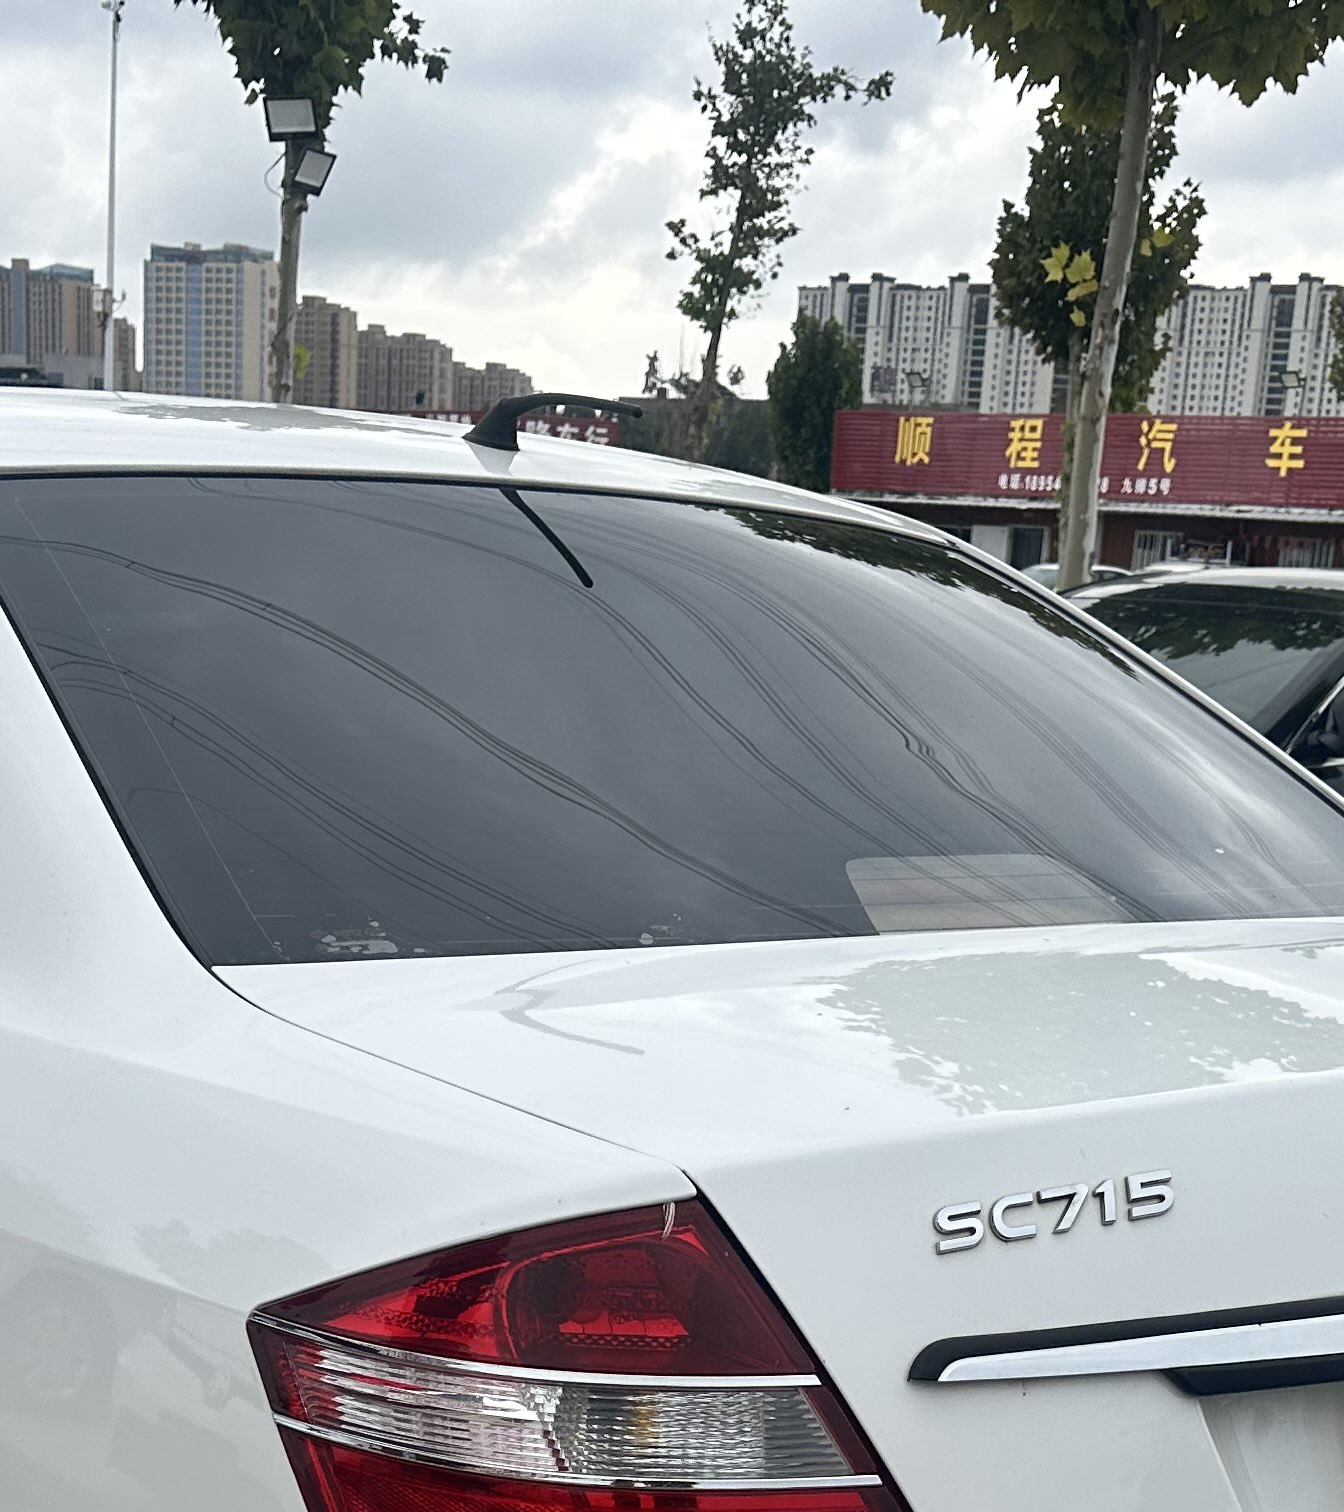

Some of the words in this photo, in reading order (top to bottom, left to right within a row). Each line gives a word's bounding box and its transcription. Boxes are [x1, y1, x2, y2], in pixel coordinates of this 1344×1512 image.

[894, 416, 1308, 477] 顺程汽车
[933, 1169, 1175, 1255] SC715
